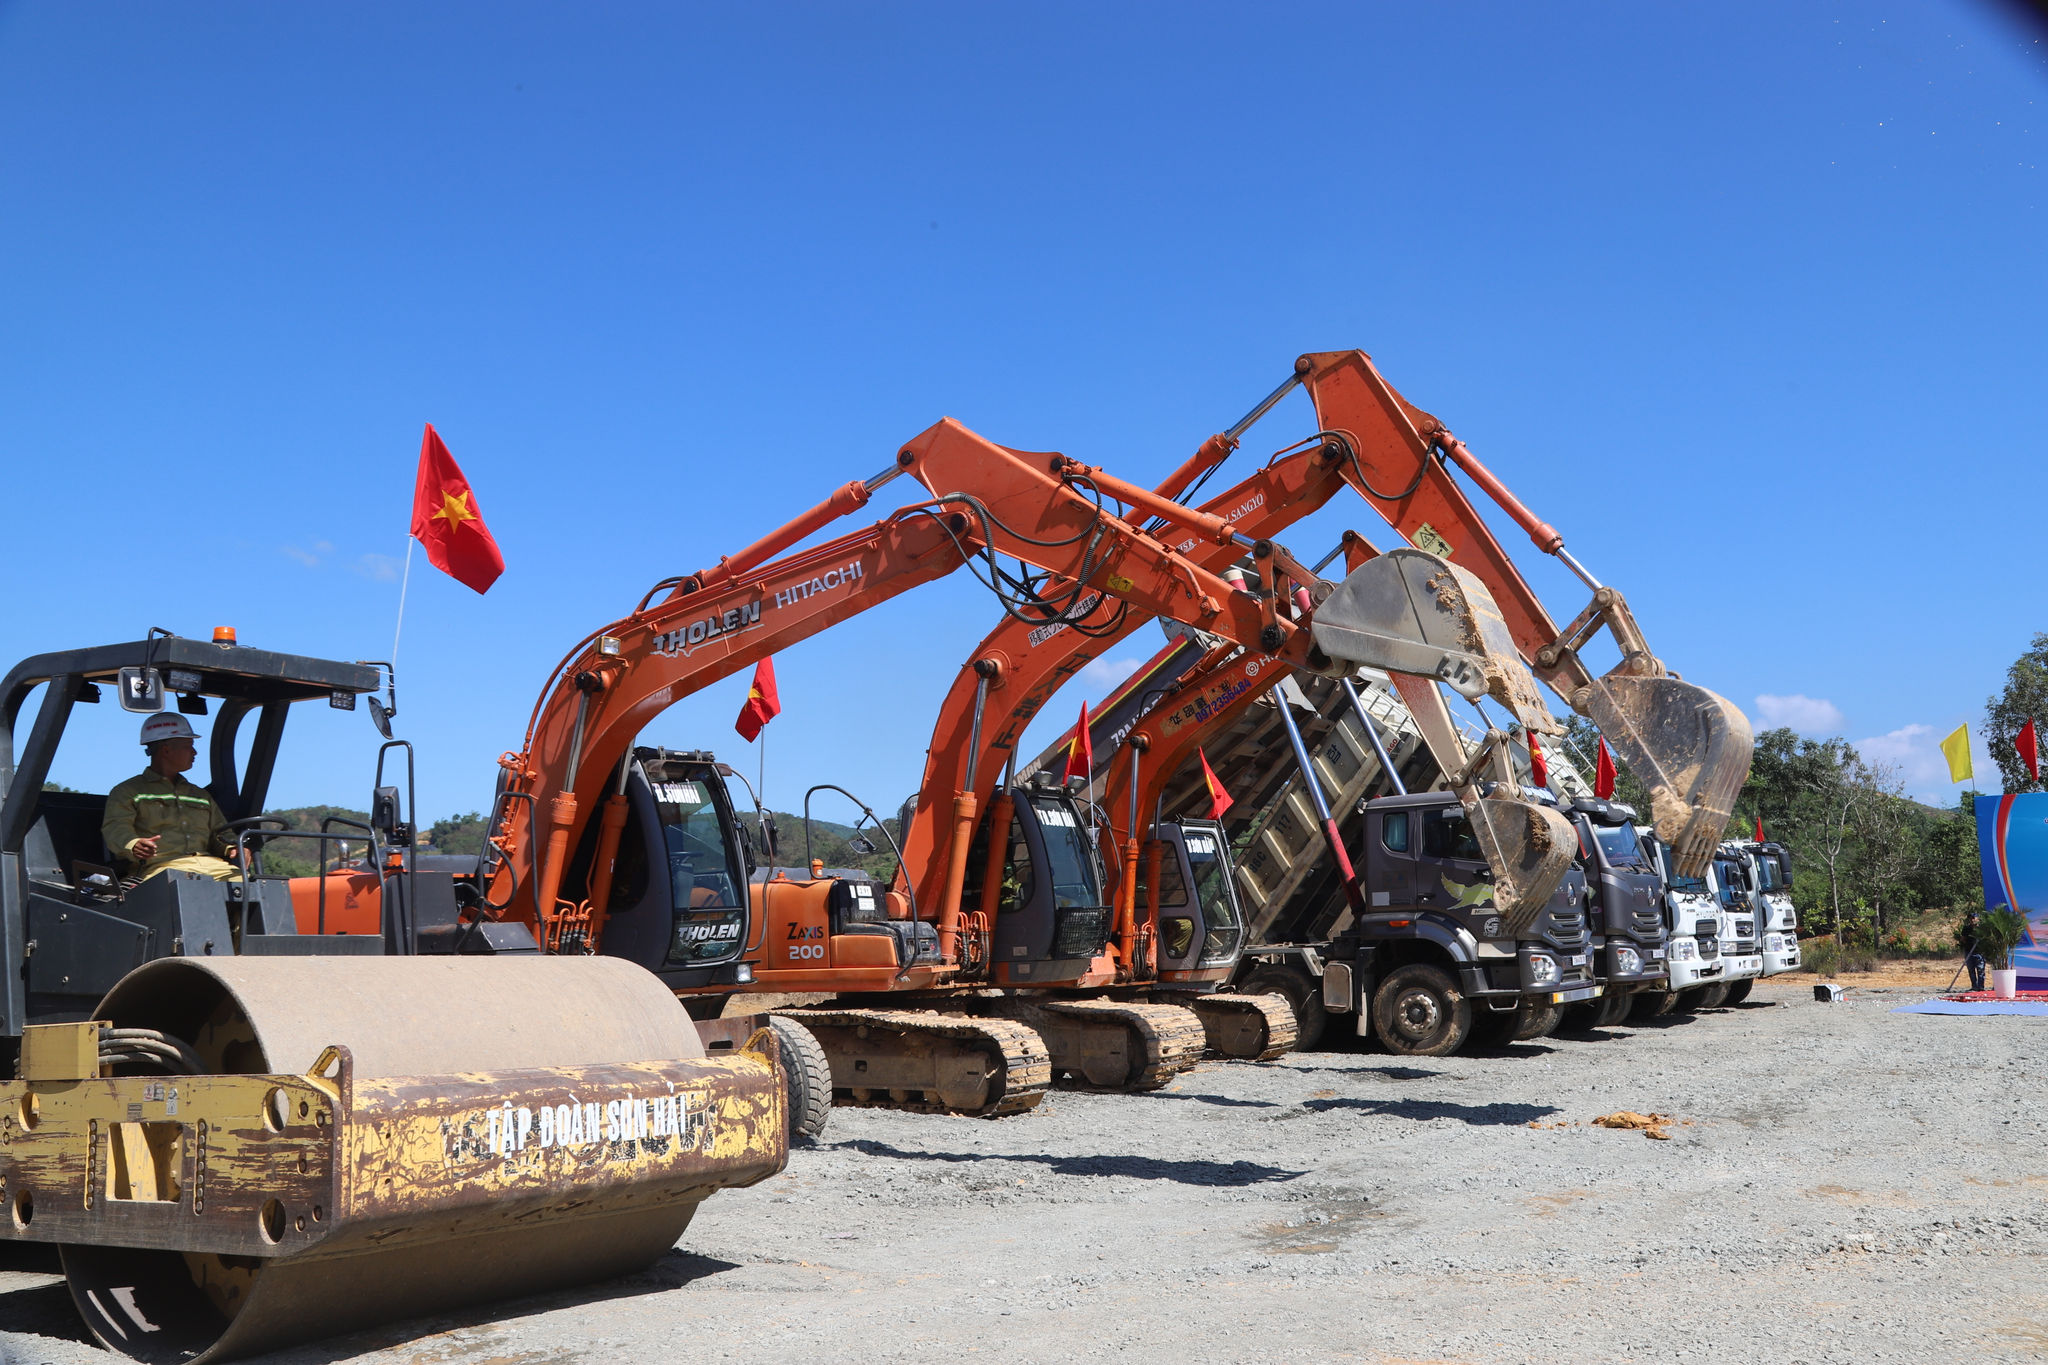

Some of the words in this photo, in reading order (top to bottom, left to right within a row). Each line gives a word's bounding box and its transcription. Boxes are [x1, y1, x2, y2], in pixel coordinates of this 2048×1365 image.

[775, 560, 863, 609] HITACHI
[652, 600, 761, 652] THOLEN
[1028, 594, 1098, 647] 移動式クレン仕様機
[1386, 737, 1398, 754] AGO
[678, 924, 740, 941] THOLEN
[788, 944, 824, 960] 200
[486, 1100, 532, 1159] TẬP
[540, 1093, 600, 1148] ĐOÀN
[607, 1093, 648, 1142] SƠN
[653, 1081, 686, 1135] HẢI
